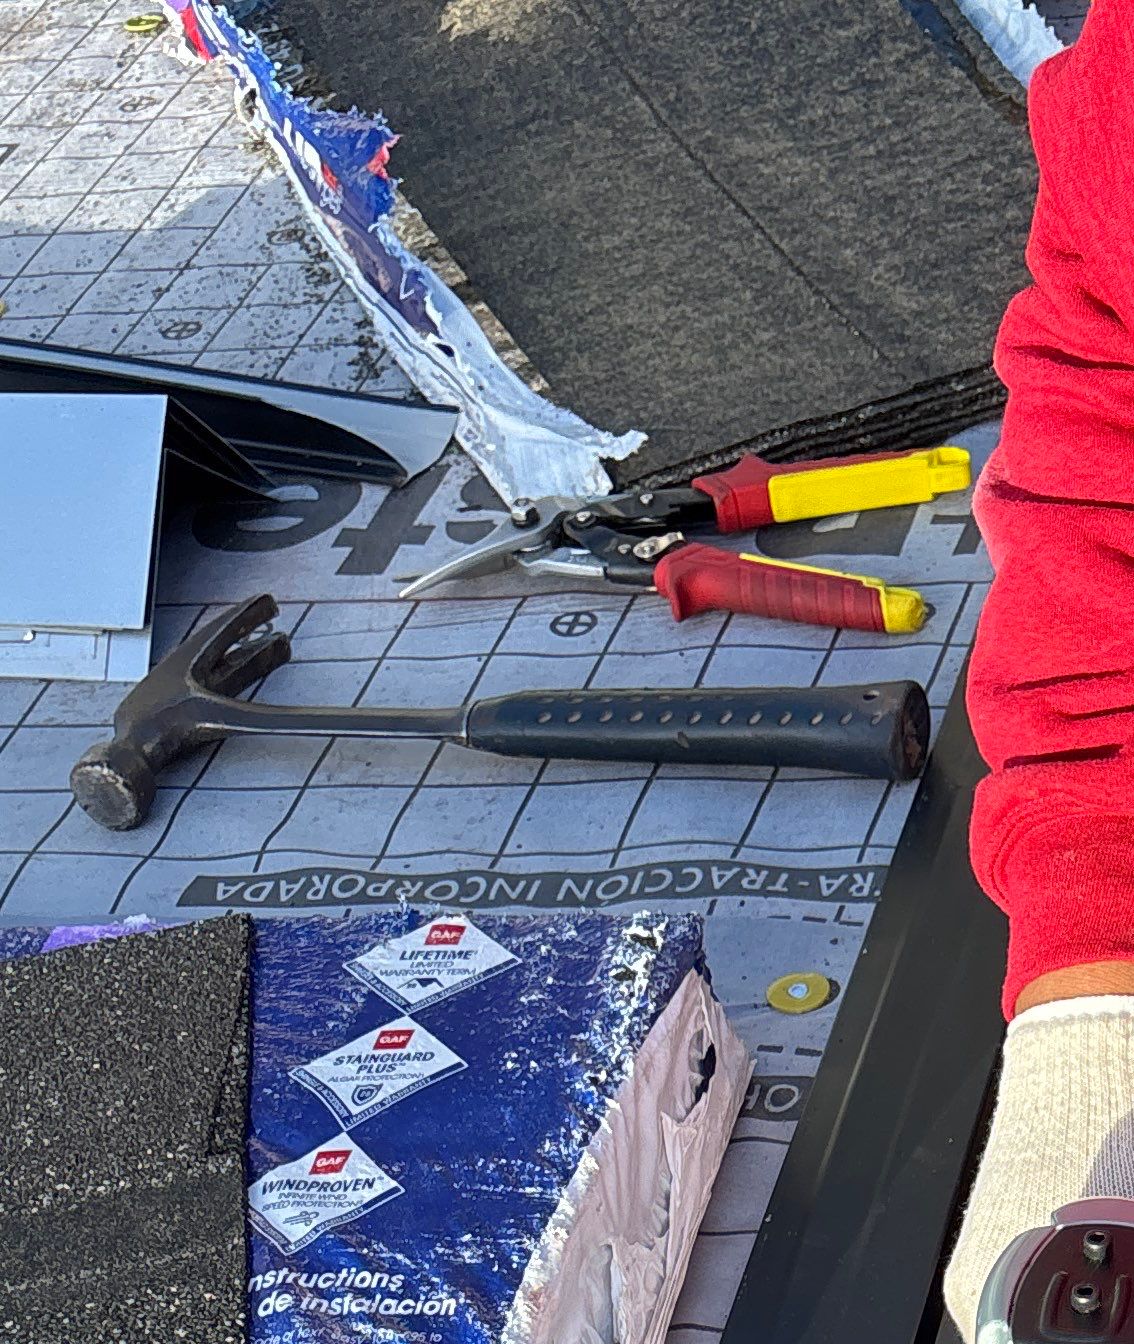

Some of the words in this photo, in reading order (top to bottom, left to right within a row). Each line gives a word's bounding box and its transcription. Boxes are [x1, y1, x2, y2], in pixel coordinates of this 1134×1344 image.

[215, 873, 542, 902] INCORPORADA
[556, 866, 881, 907] RA-TRACCIÓN
[400, 950, 476, 961] LIFETIME
[379, 968, 446, 977] WARRANTY
[333, 1051, 435, 1067] STAINGUARD
[315, 1156, 346, 1167] GAF
[262, 1176, 378, 1196] WINDPROVEN
[248, 1267, 405, 1293] nstructions
[257, 1291, 293, 1318] de
